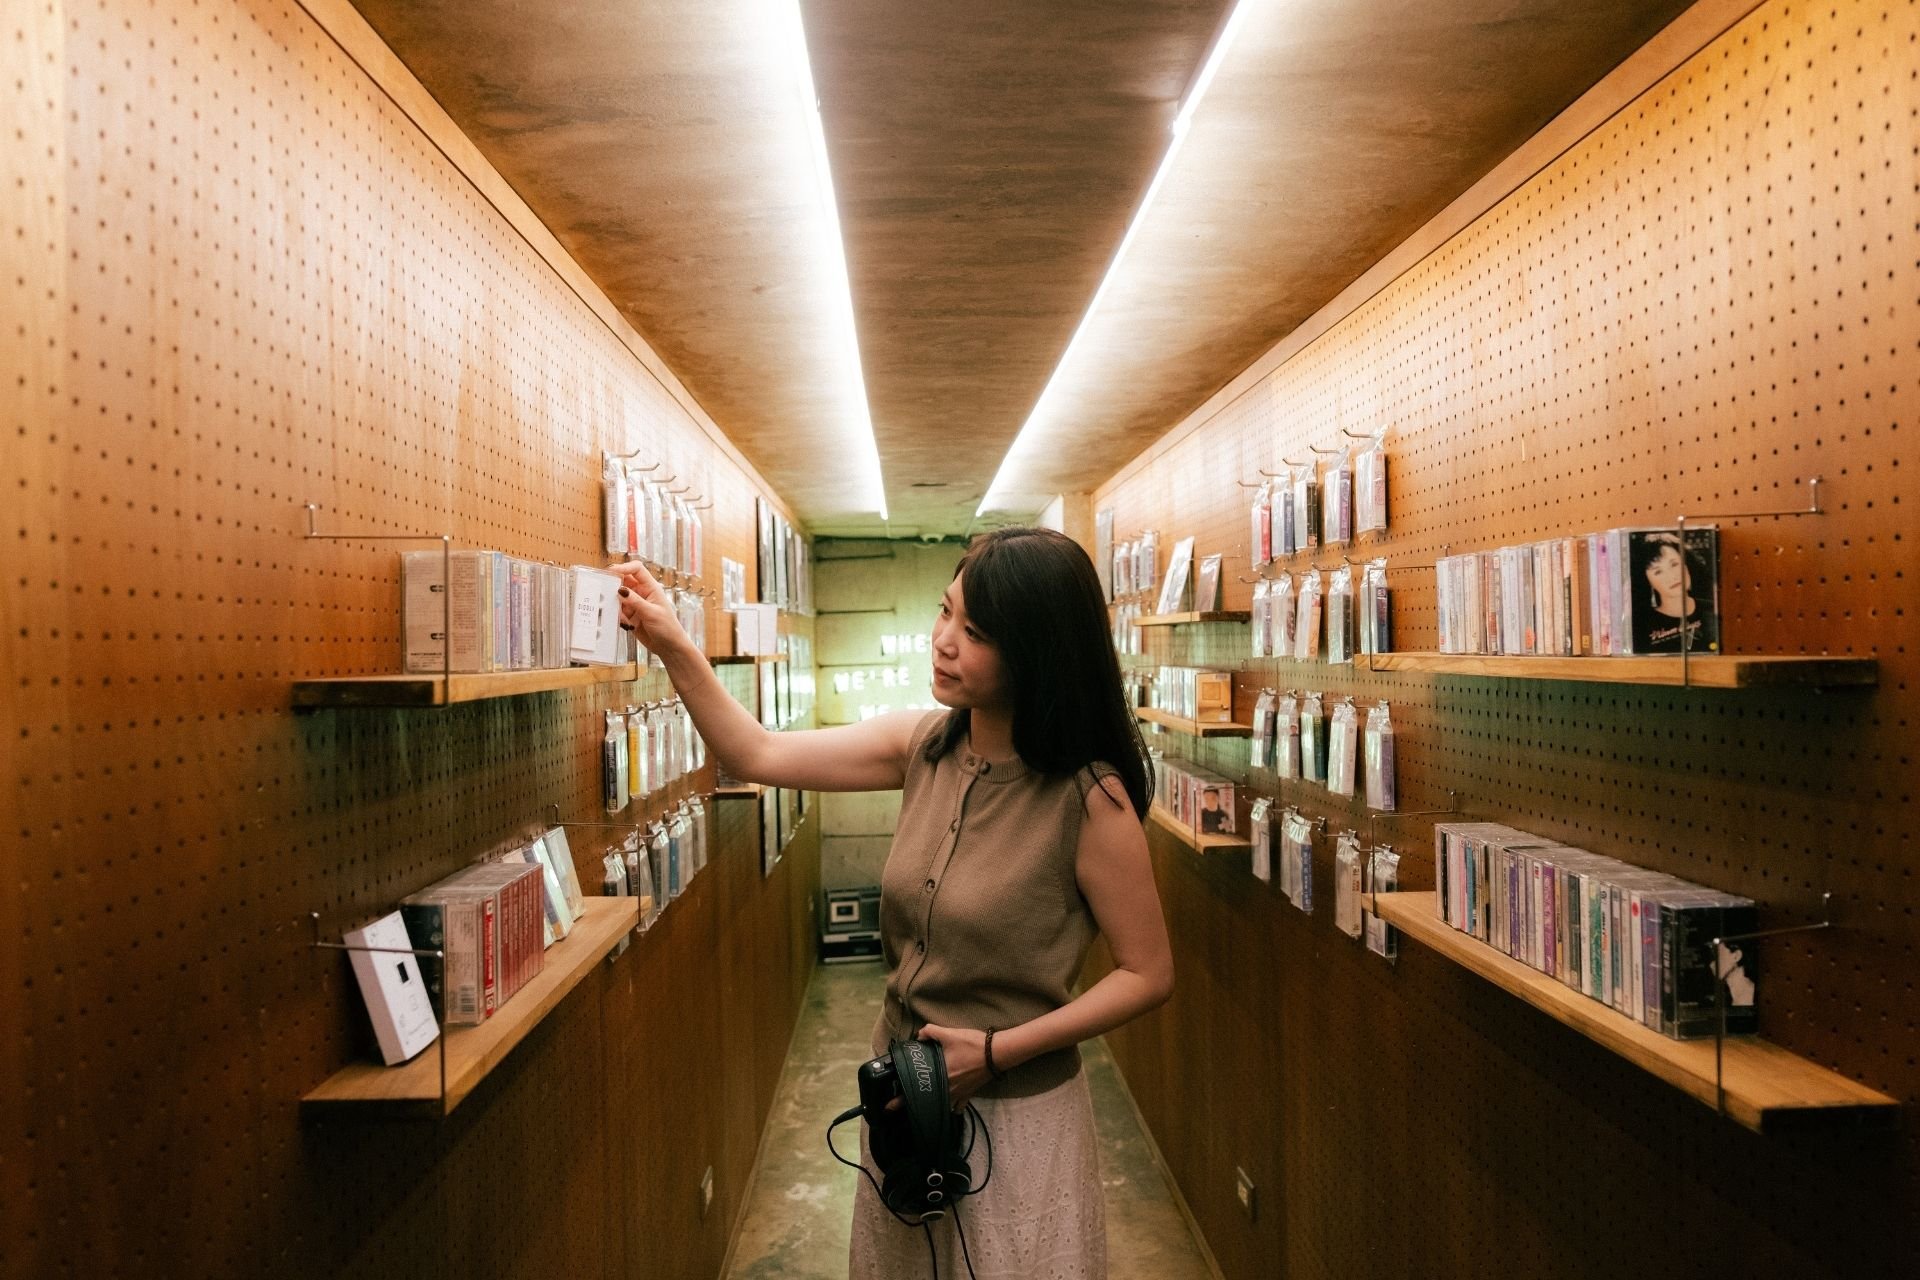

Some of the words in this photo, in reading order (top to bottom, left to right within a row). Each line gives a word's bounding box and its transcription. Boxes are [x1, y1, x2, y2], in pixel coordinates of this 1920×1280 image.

[881, 633, 927, 655] WHE
[833, 665, 910, 693] WE'RE
[904, 1040, 933, 1092] perlux
